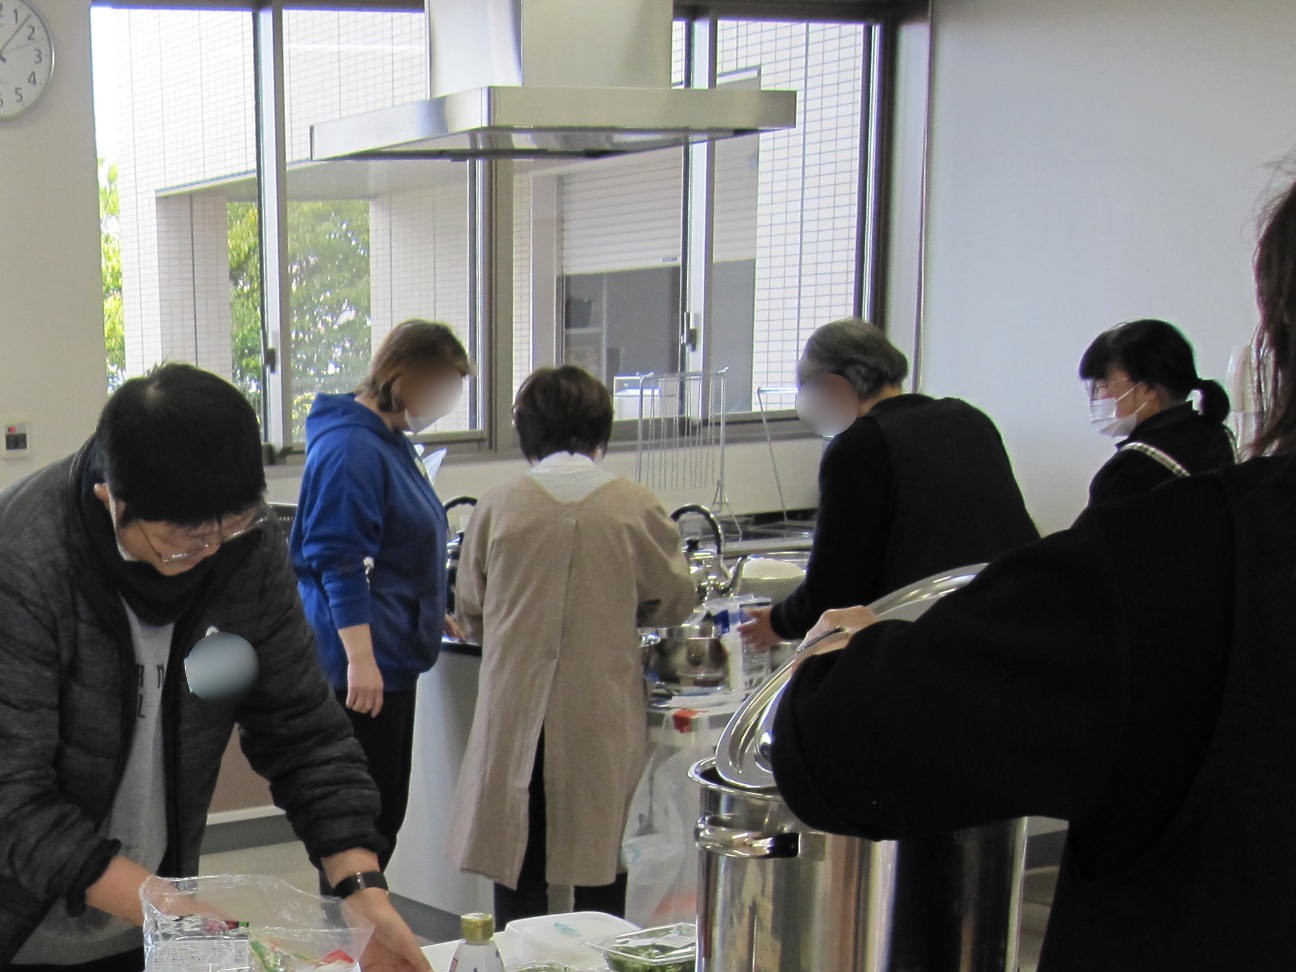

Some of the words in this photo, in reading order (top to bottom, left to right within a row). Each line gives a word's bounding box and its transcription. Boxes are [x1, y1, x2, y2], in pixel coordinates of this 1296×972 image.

[27, 25, 35, 41] 2
[34, 49, 42, 64] 3
[27, 71, 37, 86] 4
[15, 88, 24, 102] 5
